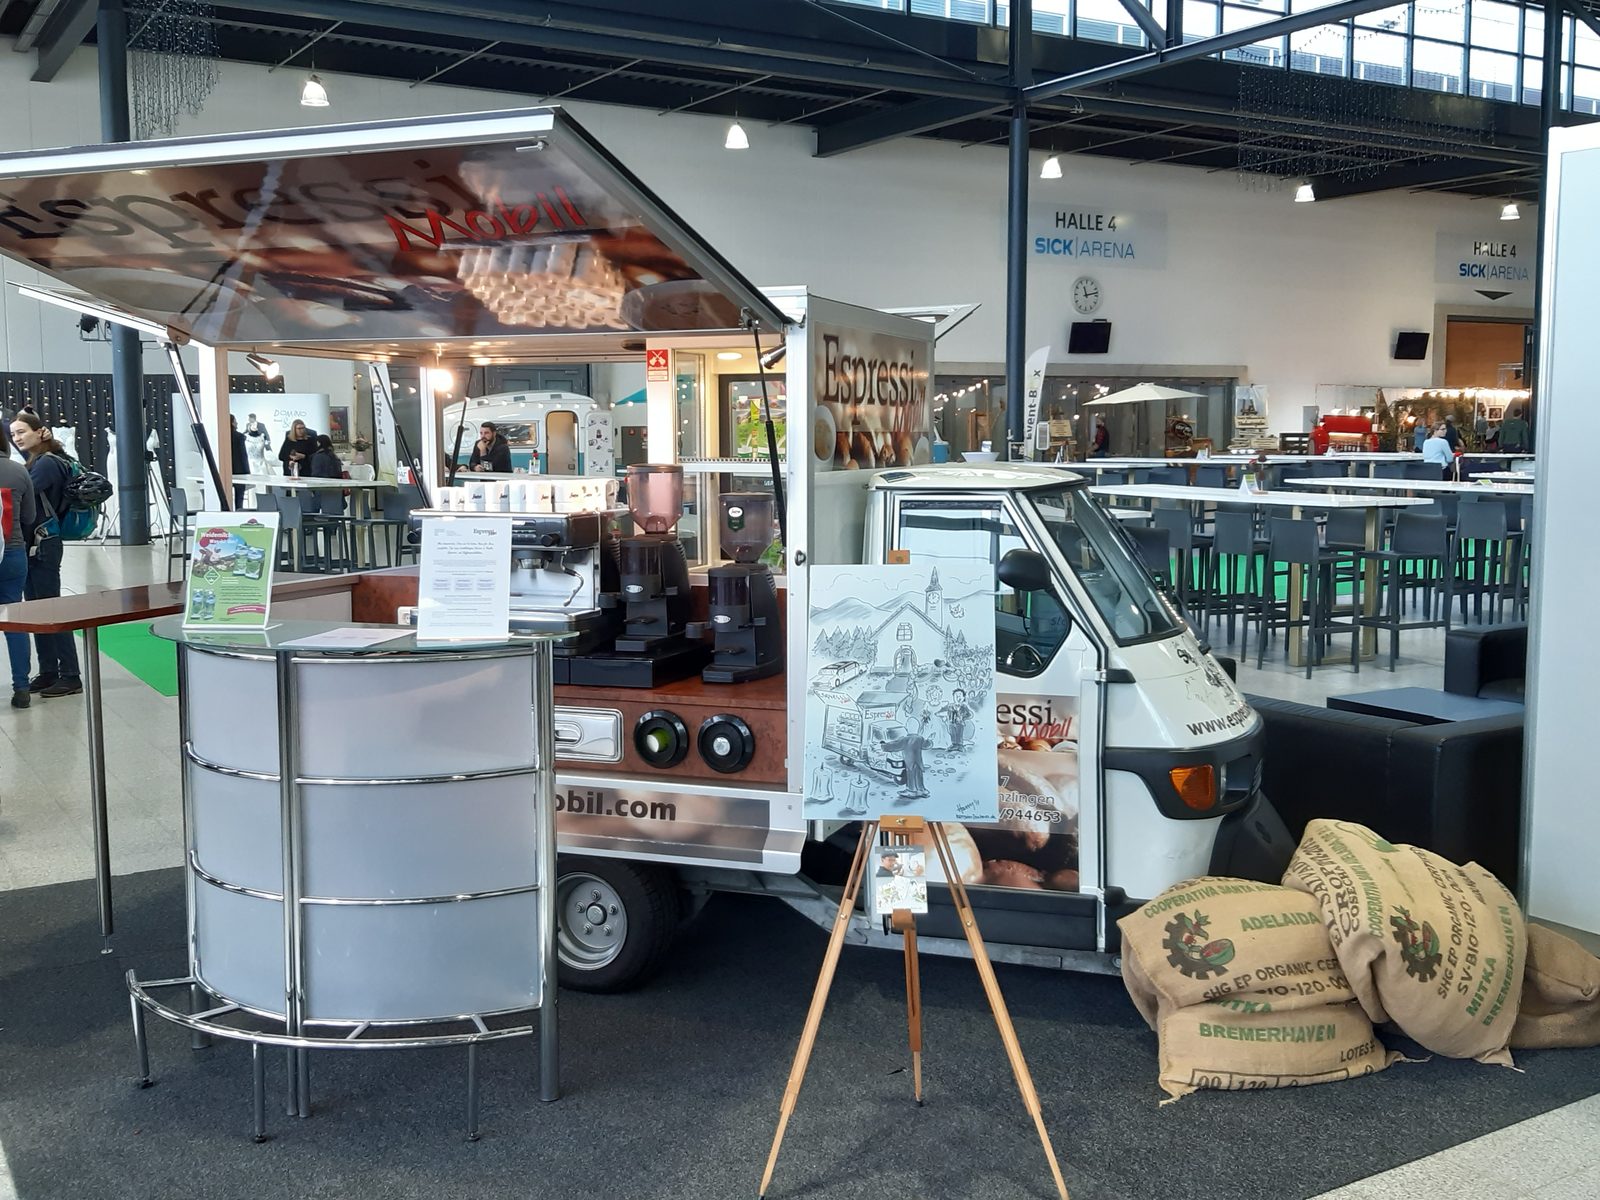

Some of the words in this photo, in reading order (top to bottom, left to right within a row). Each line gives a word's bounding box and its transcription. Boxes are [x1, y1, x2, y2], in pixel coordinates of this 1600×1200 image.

[383, 185, 588, 250] Mobil
[1055, 211, 1103, 231] HALLE
[1107, 215, 1117, 232] 4
[1035, 237, 1074, 256] SICK
[1080, 241, 1135, 259] ARENA
[1473, 241, 1507, 258] HALLE
[1510, 244, 1517, 258] 4
[1459, 263, 1486, 278] SICK
[1490, 265, 1529, 281] ARENA
[823, 334, 916, 425] Espressi
[996, 700, 1056, 727] essi
[1000, 776, 1010, 788] 7
[556, 790, 677, 821] obil.com
[1143, 884, 1220, 919] COOPERATIVA
[1217, 883, 1255, 898] SANTA
[1320, 865, 1352, 938] CROP
[1334, 865, 1360, 933] COSECHA
[1240, 911, 1321, 932] ADELAIDA
[1326, 909, 1343, 948] EL
[1440, 892, 1463, 946] ORGANIC
[1447, 949, 1459, 966] EP
[1481, 905, 1516, 1027] BREMERHAVEN
[1203, 982, 1232, 1000] SHG
[1233, 973, 1253, 990] EP
[1255, 961, 1314, 982] ORGANIC
[1437, 967, 1454, 999] SHG
[1466, 956, 1497, 1017] MITKA
[1199, 1022, 1336, 1044] BREMERHAVEN
